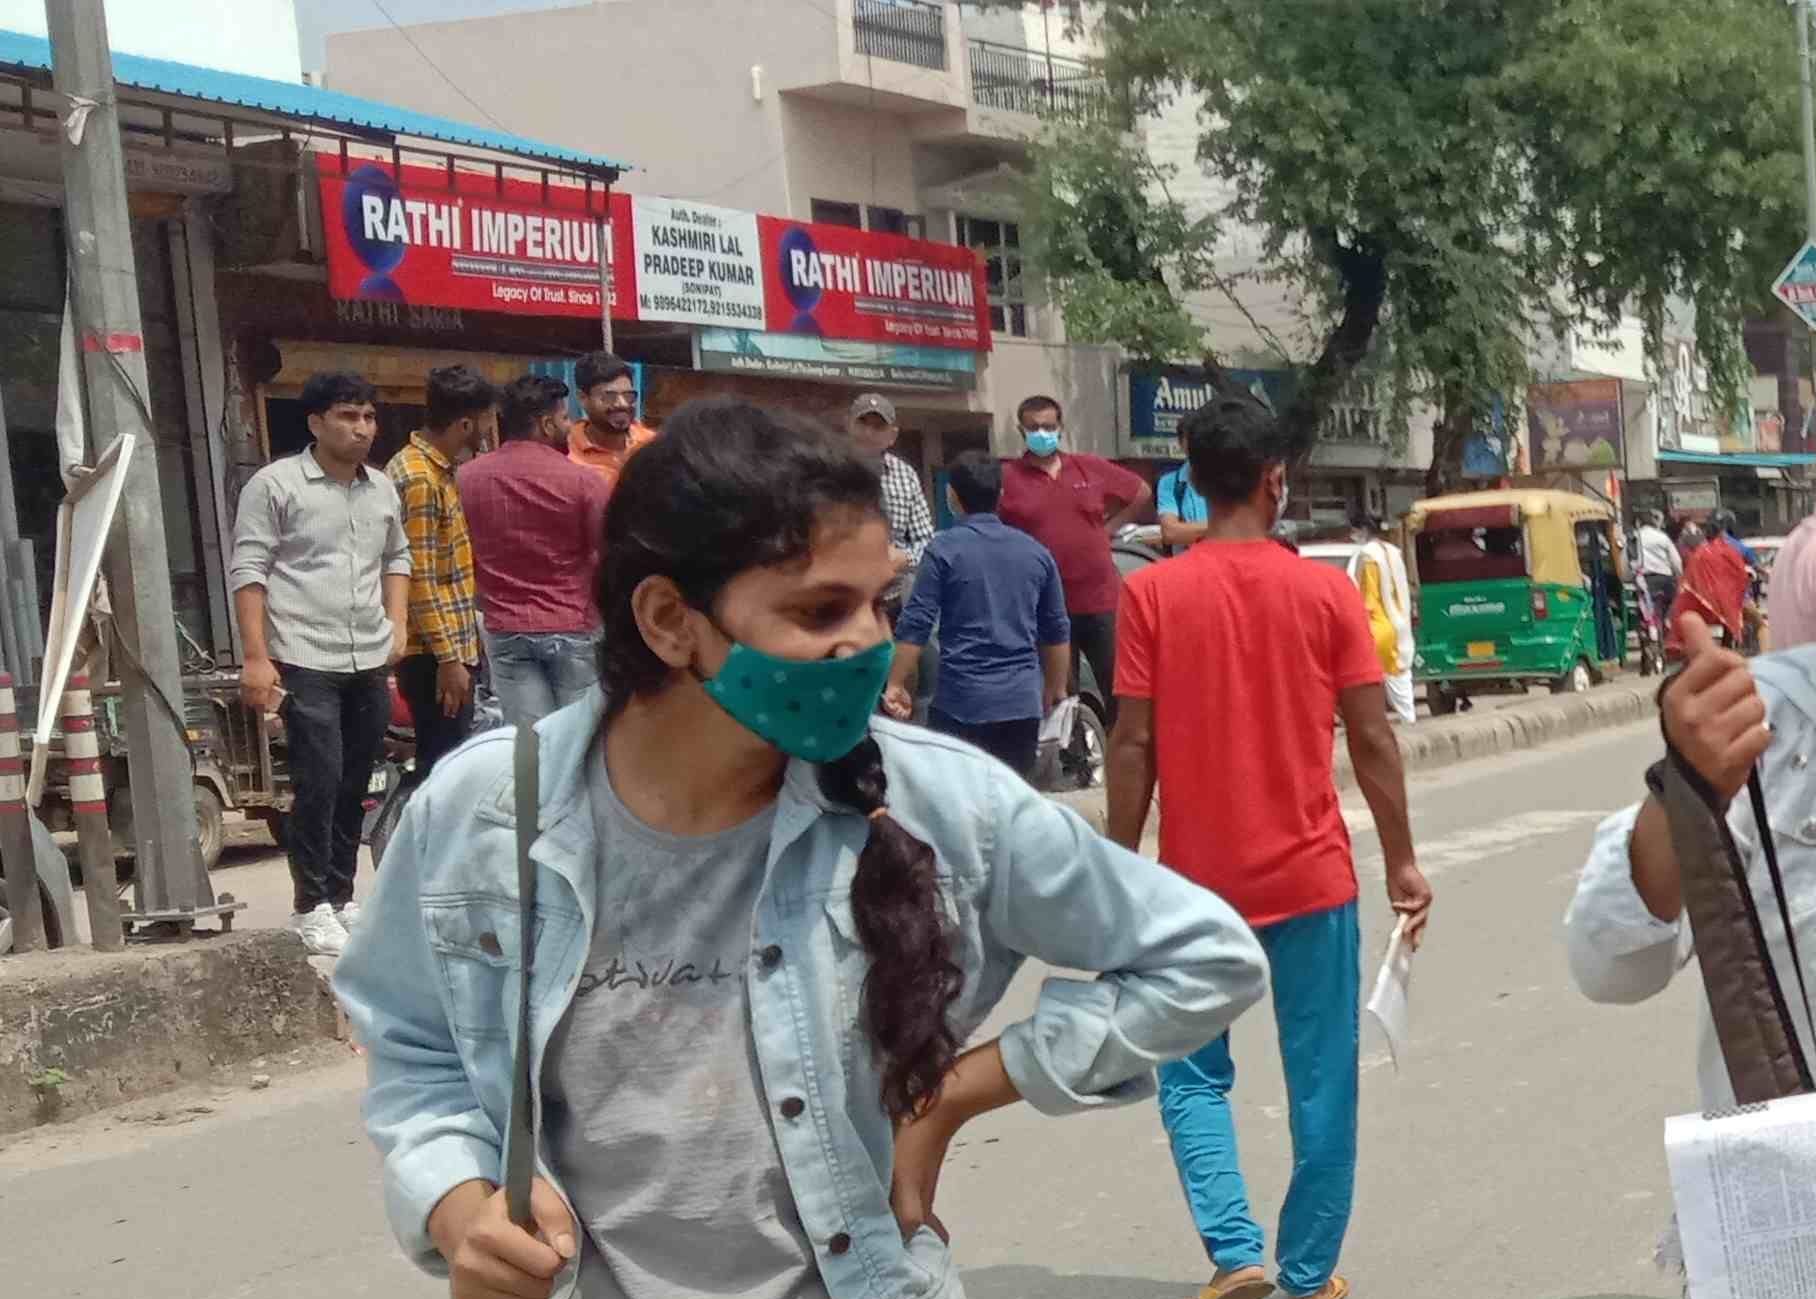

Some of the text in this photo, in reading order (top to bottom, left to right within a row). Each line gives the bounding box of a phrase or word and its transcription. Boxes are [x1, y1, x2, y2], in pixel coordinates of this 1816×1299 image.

[361, 194, 614, 265] RATHI IMPERIUM
[651, 224, 743, 257] KASHMIRI LAL
[643, 253, 755, 286] PRADEEP KUMAR
[790, 248, 974, 307] RATHI IMPERIUM
[492, 281, 528, 303] Legacy
[1153, 375, 1213, 411] Amul
[575, 956, 737, 997] otivat
